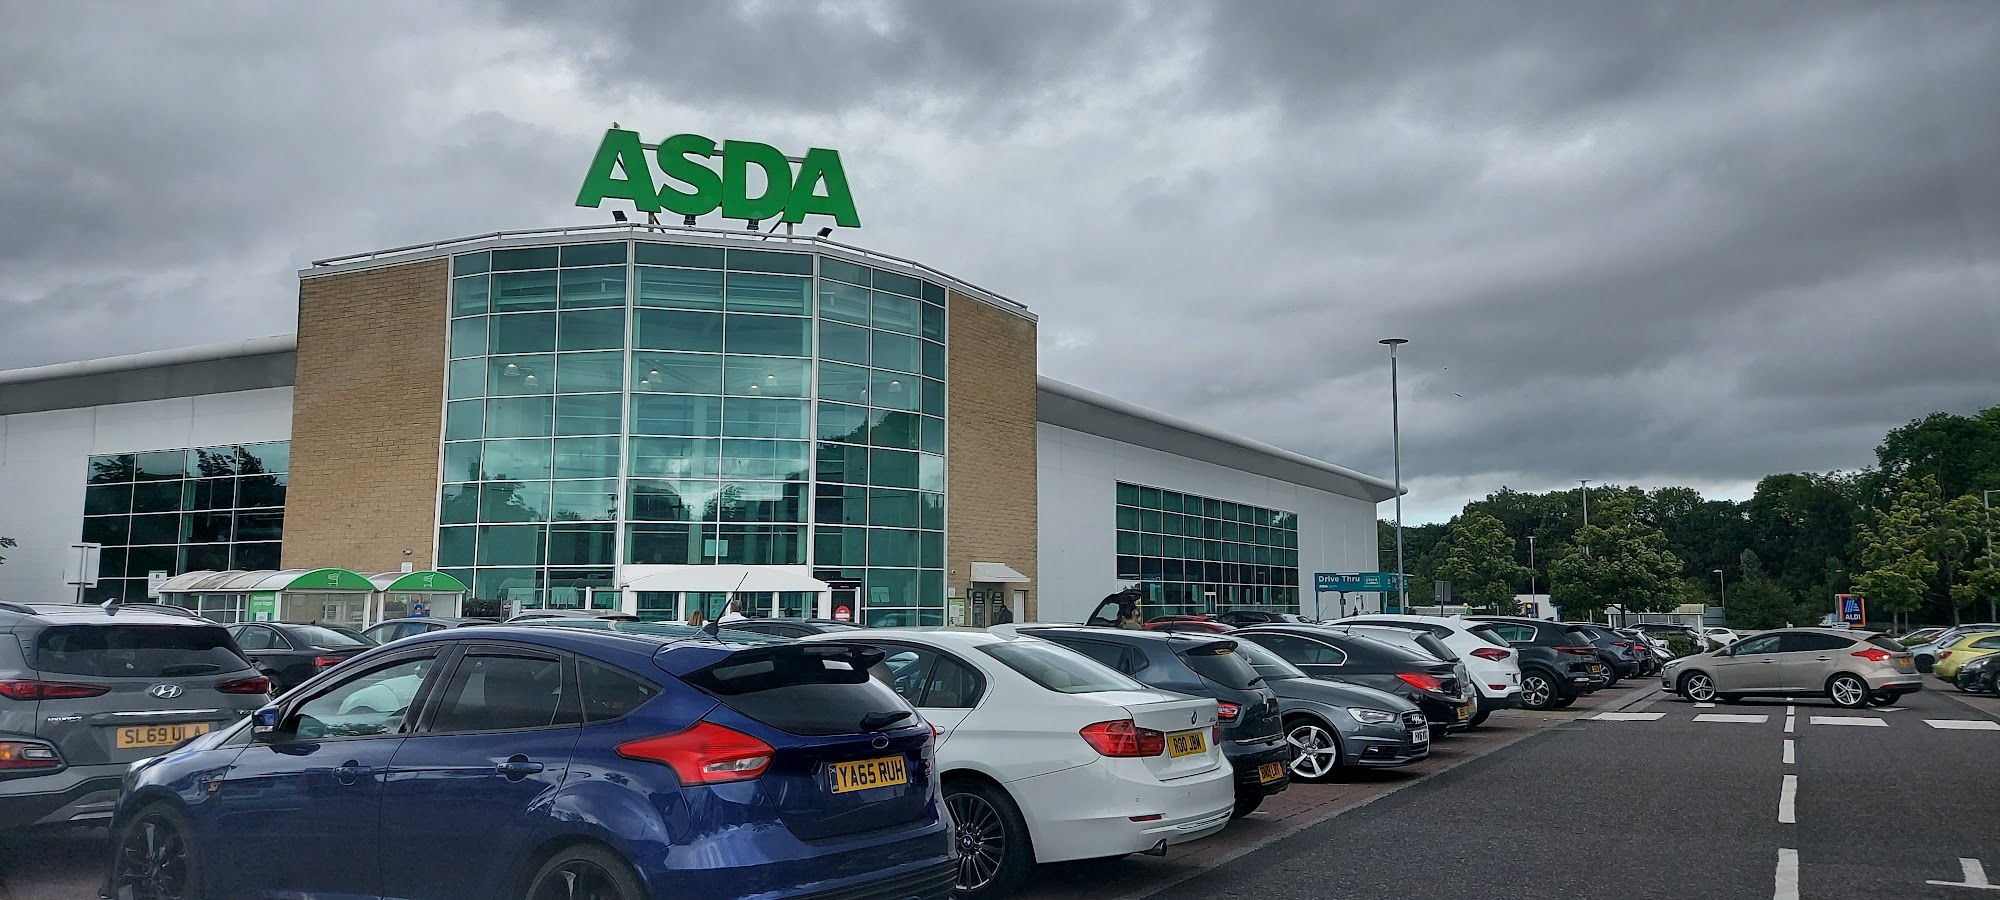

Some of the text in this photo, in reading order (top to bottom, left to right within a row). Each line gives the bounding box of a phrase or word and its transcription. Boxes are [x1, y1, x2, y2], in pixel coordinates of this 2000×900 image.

[575, 128, 861, 228] ASDA
[124, 728, 168, 744] SL69
[838, 763, 877, 788] YA65
[878, 760, 905, 783] RUH
